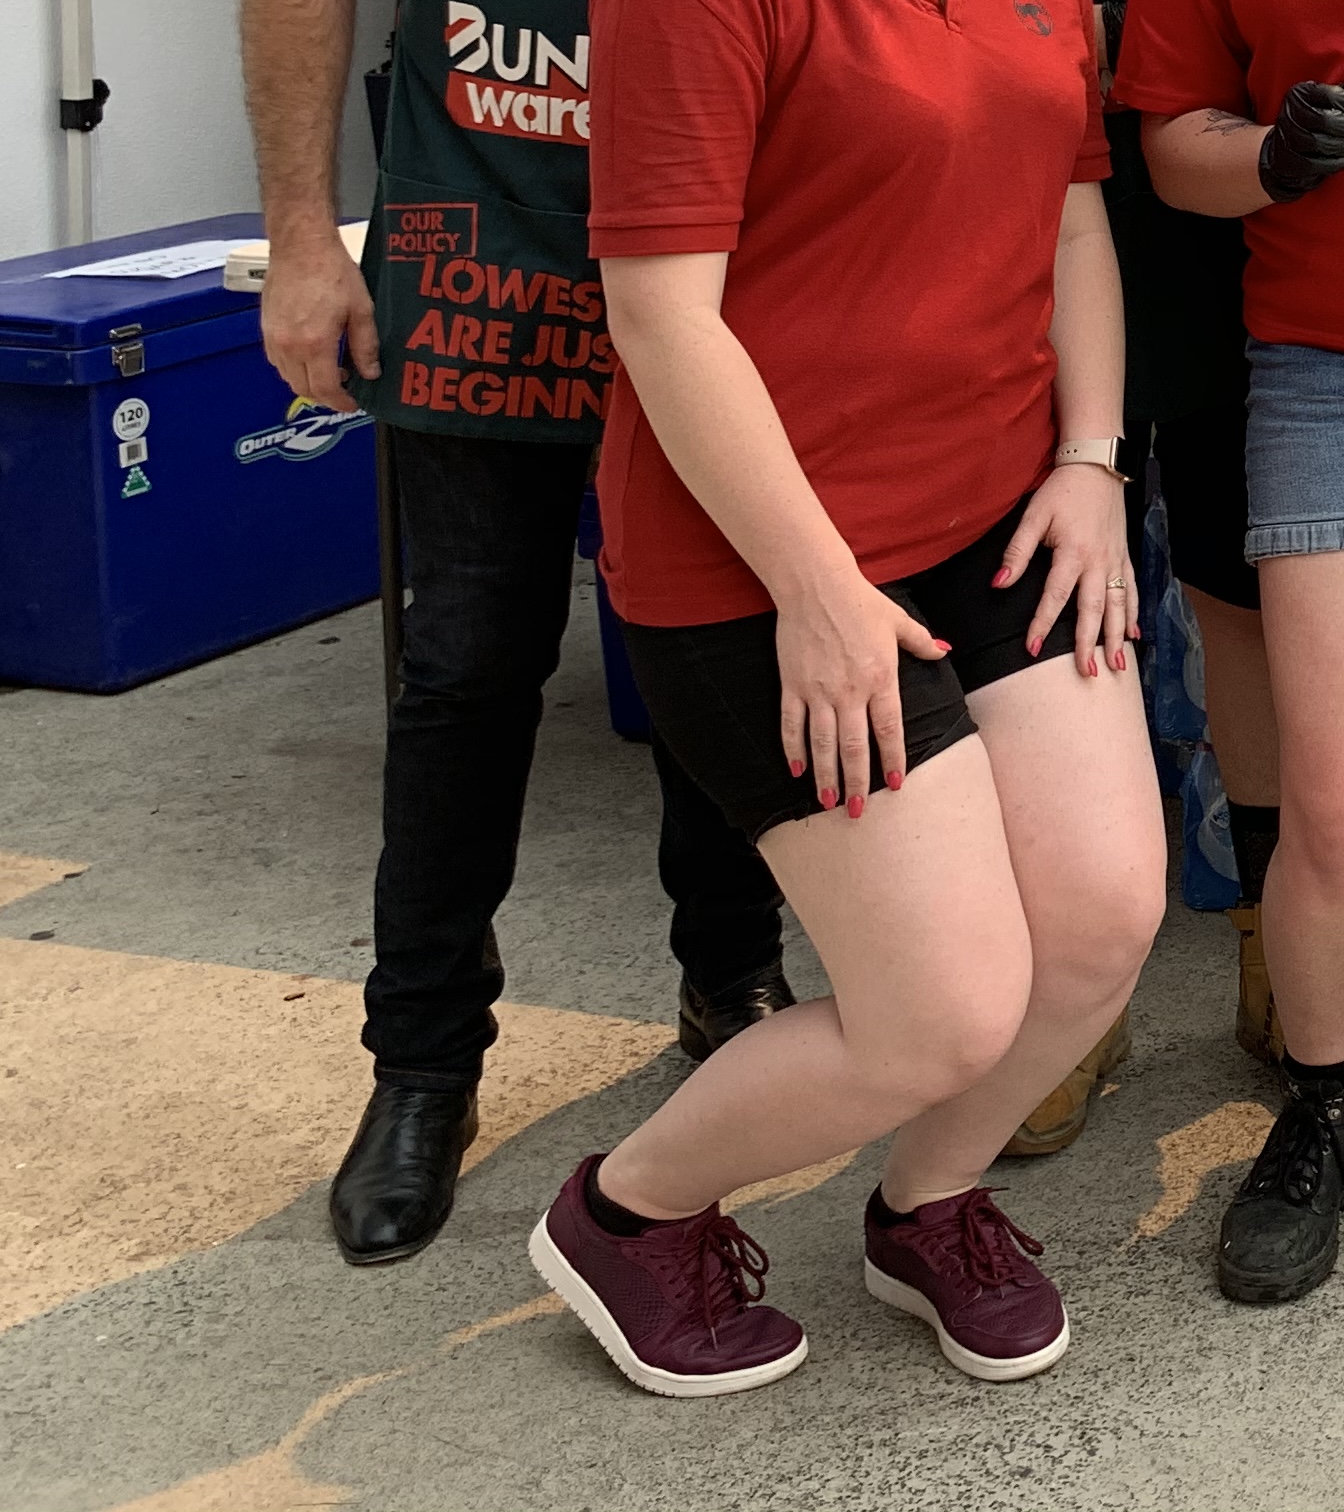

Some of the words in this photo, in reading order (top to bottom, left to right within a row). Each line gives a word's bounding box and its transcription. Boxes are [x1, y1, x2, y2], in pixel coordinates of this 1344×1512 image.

[401, 209, 444, 232] OUR
[388, 231, 461, 254] POLICY
[406, 307, 514, 365] ARE
[120, 407, 144, 423] 120
[240, 427, 297, 456] OUTER
